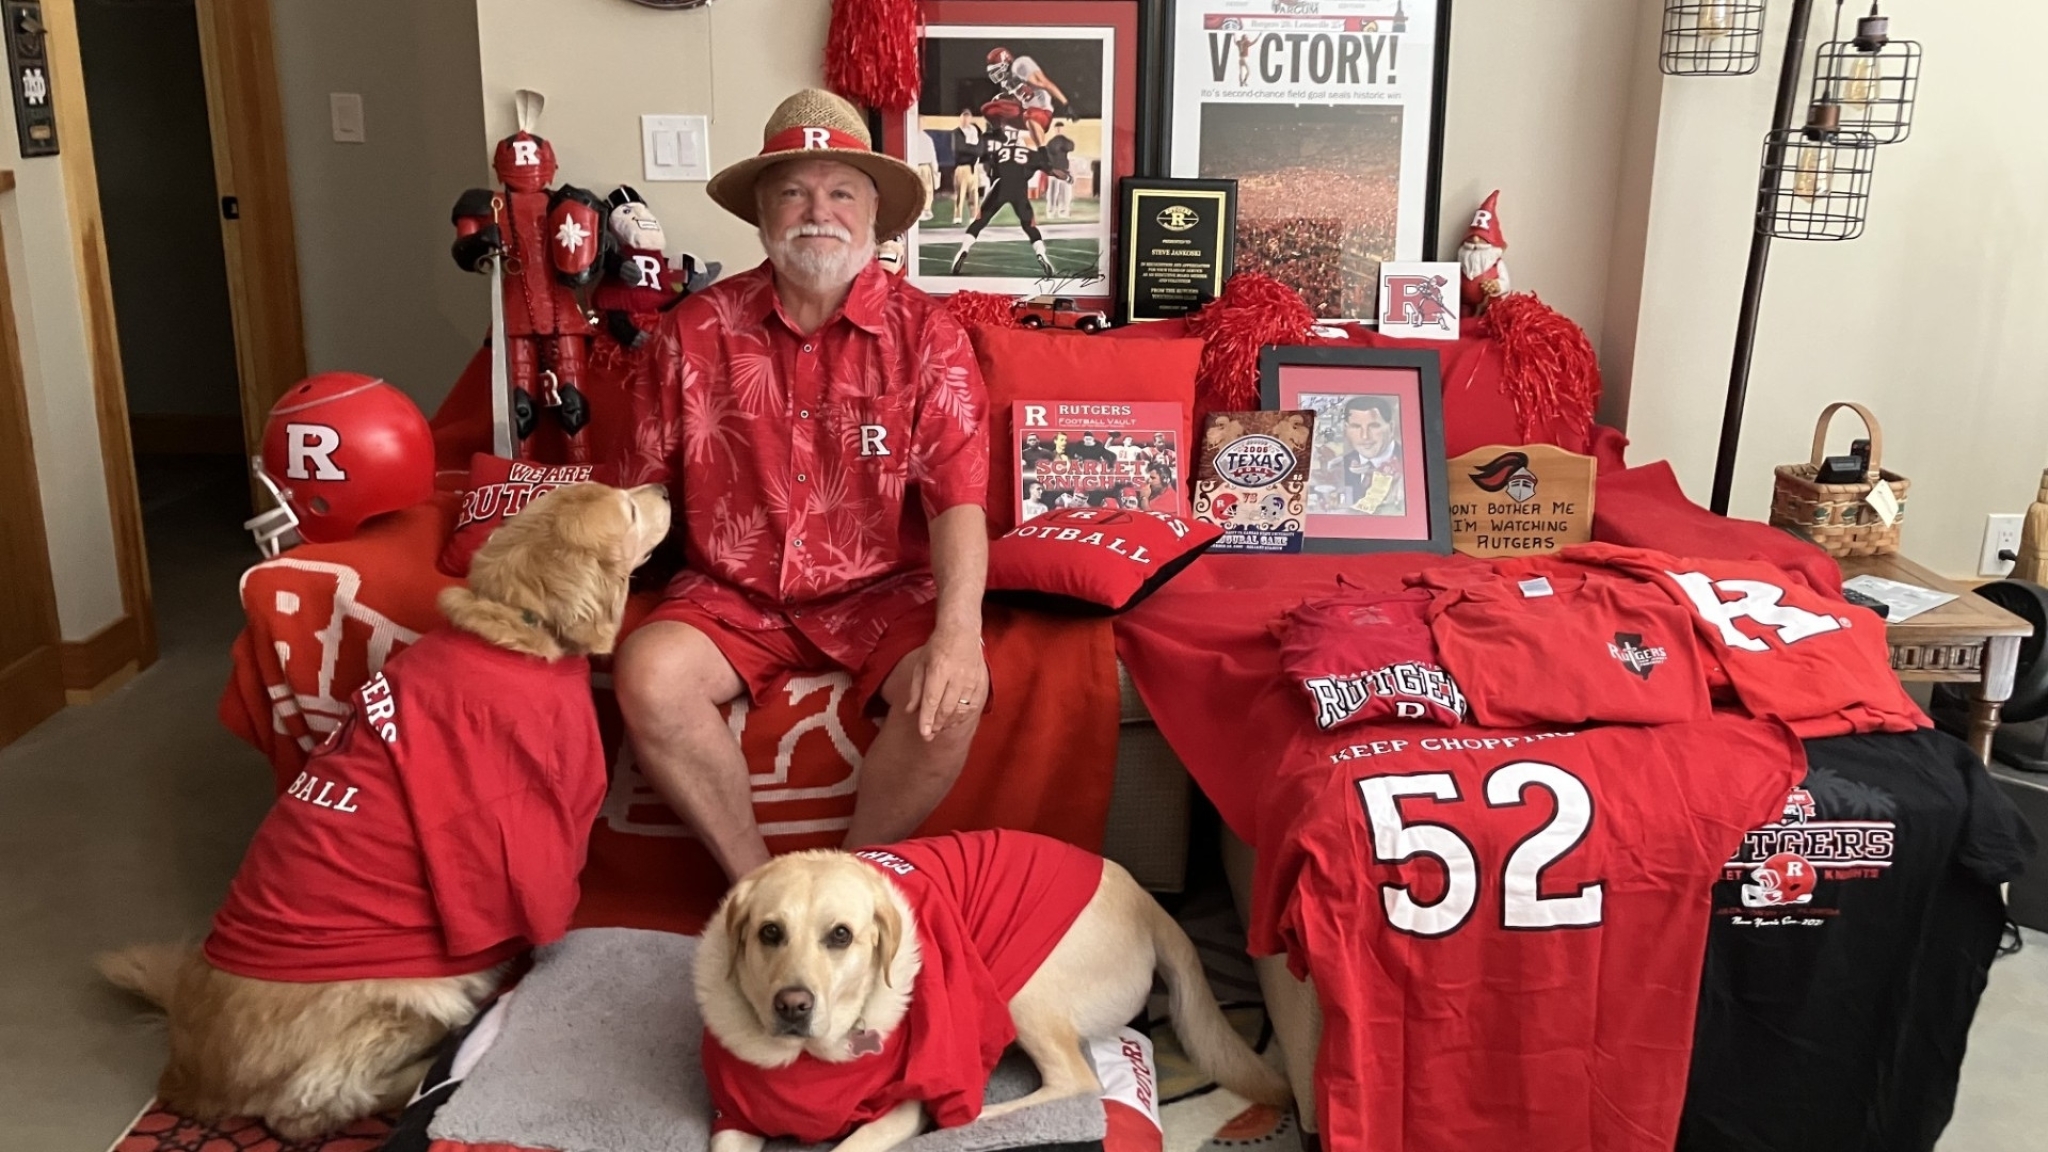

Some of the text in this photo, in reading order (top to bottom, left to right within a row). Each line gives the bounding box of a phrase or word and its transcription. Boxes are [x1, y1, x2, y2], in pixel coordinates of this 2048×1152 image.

[1287, 89, 1306, 99] field
[1307, 90, 1326, 100] goal
[1328, 90, 1351, 99] seals
[1353, 90, 1385, 99] historic
[802, 127, 830, 151] R
[512, 141, 540, 166] R
[998, 147, 1028, 164] 35
[1171, 212, 1185, 226] R
[1470, 210, 1492, 229] R
[632, 254, 662, 291] R
[1383, 275, 1440, 325] R
[1024, 405, 1049, 427] R
[1058, 404, 1132, 416] RUTGERS
[1058, 417, 1105, 426] FOOTBALL
[1106, 418, 1137, 426] VAULT
[860, 425, 891, 456] R
[286, 422, 348, 481] R
[1227, 452, 1284, 471] TEXAS
[509, 462, 593, 483] WE ARE
[1036, 460, 1146, 476] SCARLET
[1037, 475, 1146, 491] KNIGHTS
[1067, 510, 1098, 520] R
[1487, 502, 1541, 515] BOTHER
[1552, 501, 1575, 515] ME
[1453, 519, 1568, 532] I'M WATCHING
[1477, 535, 1555, 549] RUTGERS
[1663, 570, 1842, 652] R
[1606, 641, 1667, 664] RUTGERS
[1329, 739, 1408, 765] KEEP
[287, 771, 358, 813] BALL
[1355, 759, 1607, 940] 52
[1730, 828, 1894, 859] TGERS
[1786, 861, 1803, 876] R
